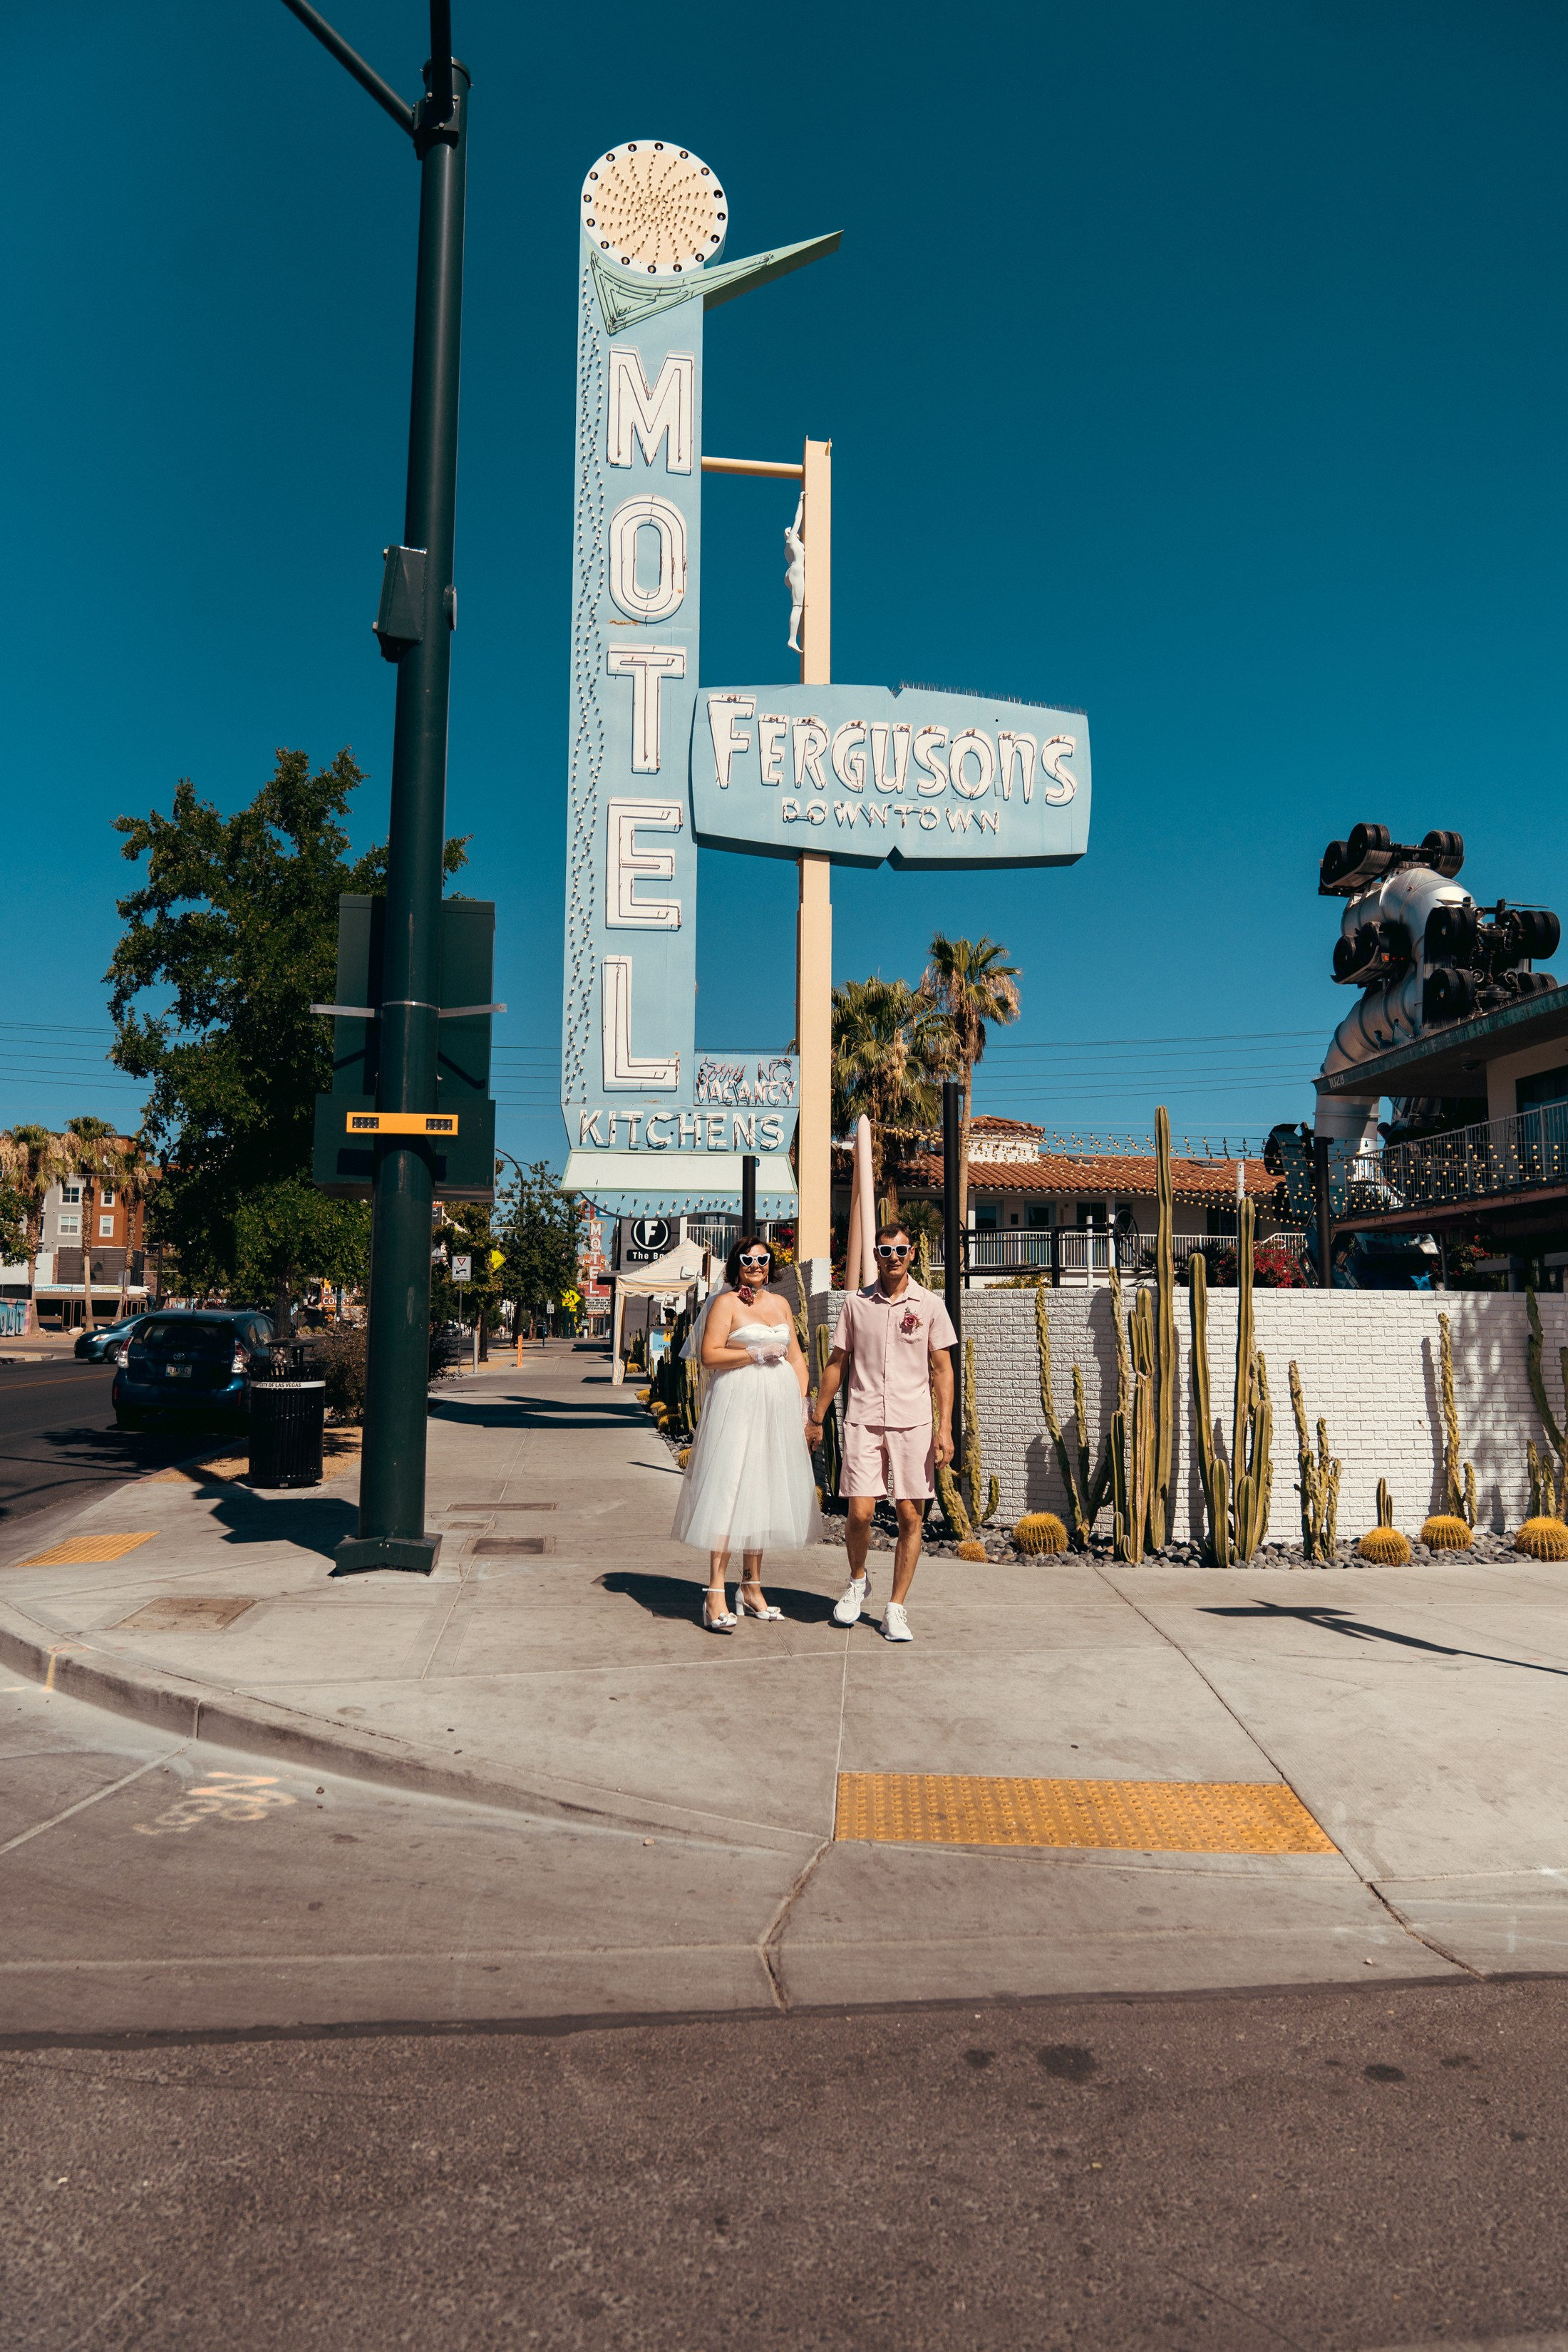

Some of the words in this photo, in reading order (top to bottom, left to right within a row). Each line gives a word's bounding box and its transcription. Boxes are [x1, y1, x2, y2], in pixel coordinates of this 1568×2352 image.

[602, 343, 695, 1089] MOTEL
[782, 796, 1001, 834] DOWNTOWN
[758, 1058, 795, 1083] NO
[1328, 1074, 1345, 1089] 1028
[696, 1080, 798, 1105] VACANCY
[579, 1109, 785, 1150] KITCHENS
[589, 1222, 602, 1294] MOTEL
